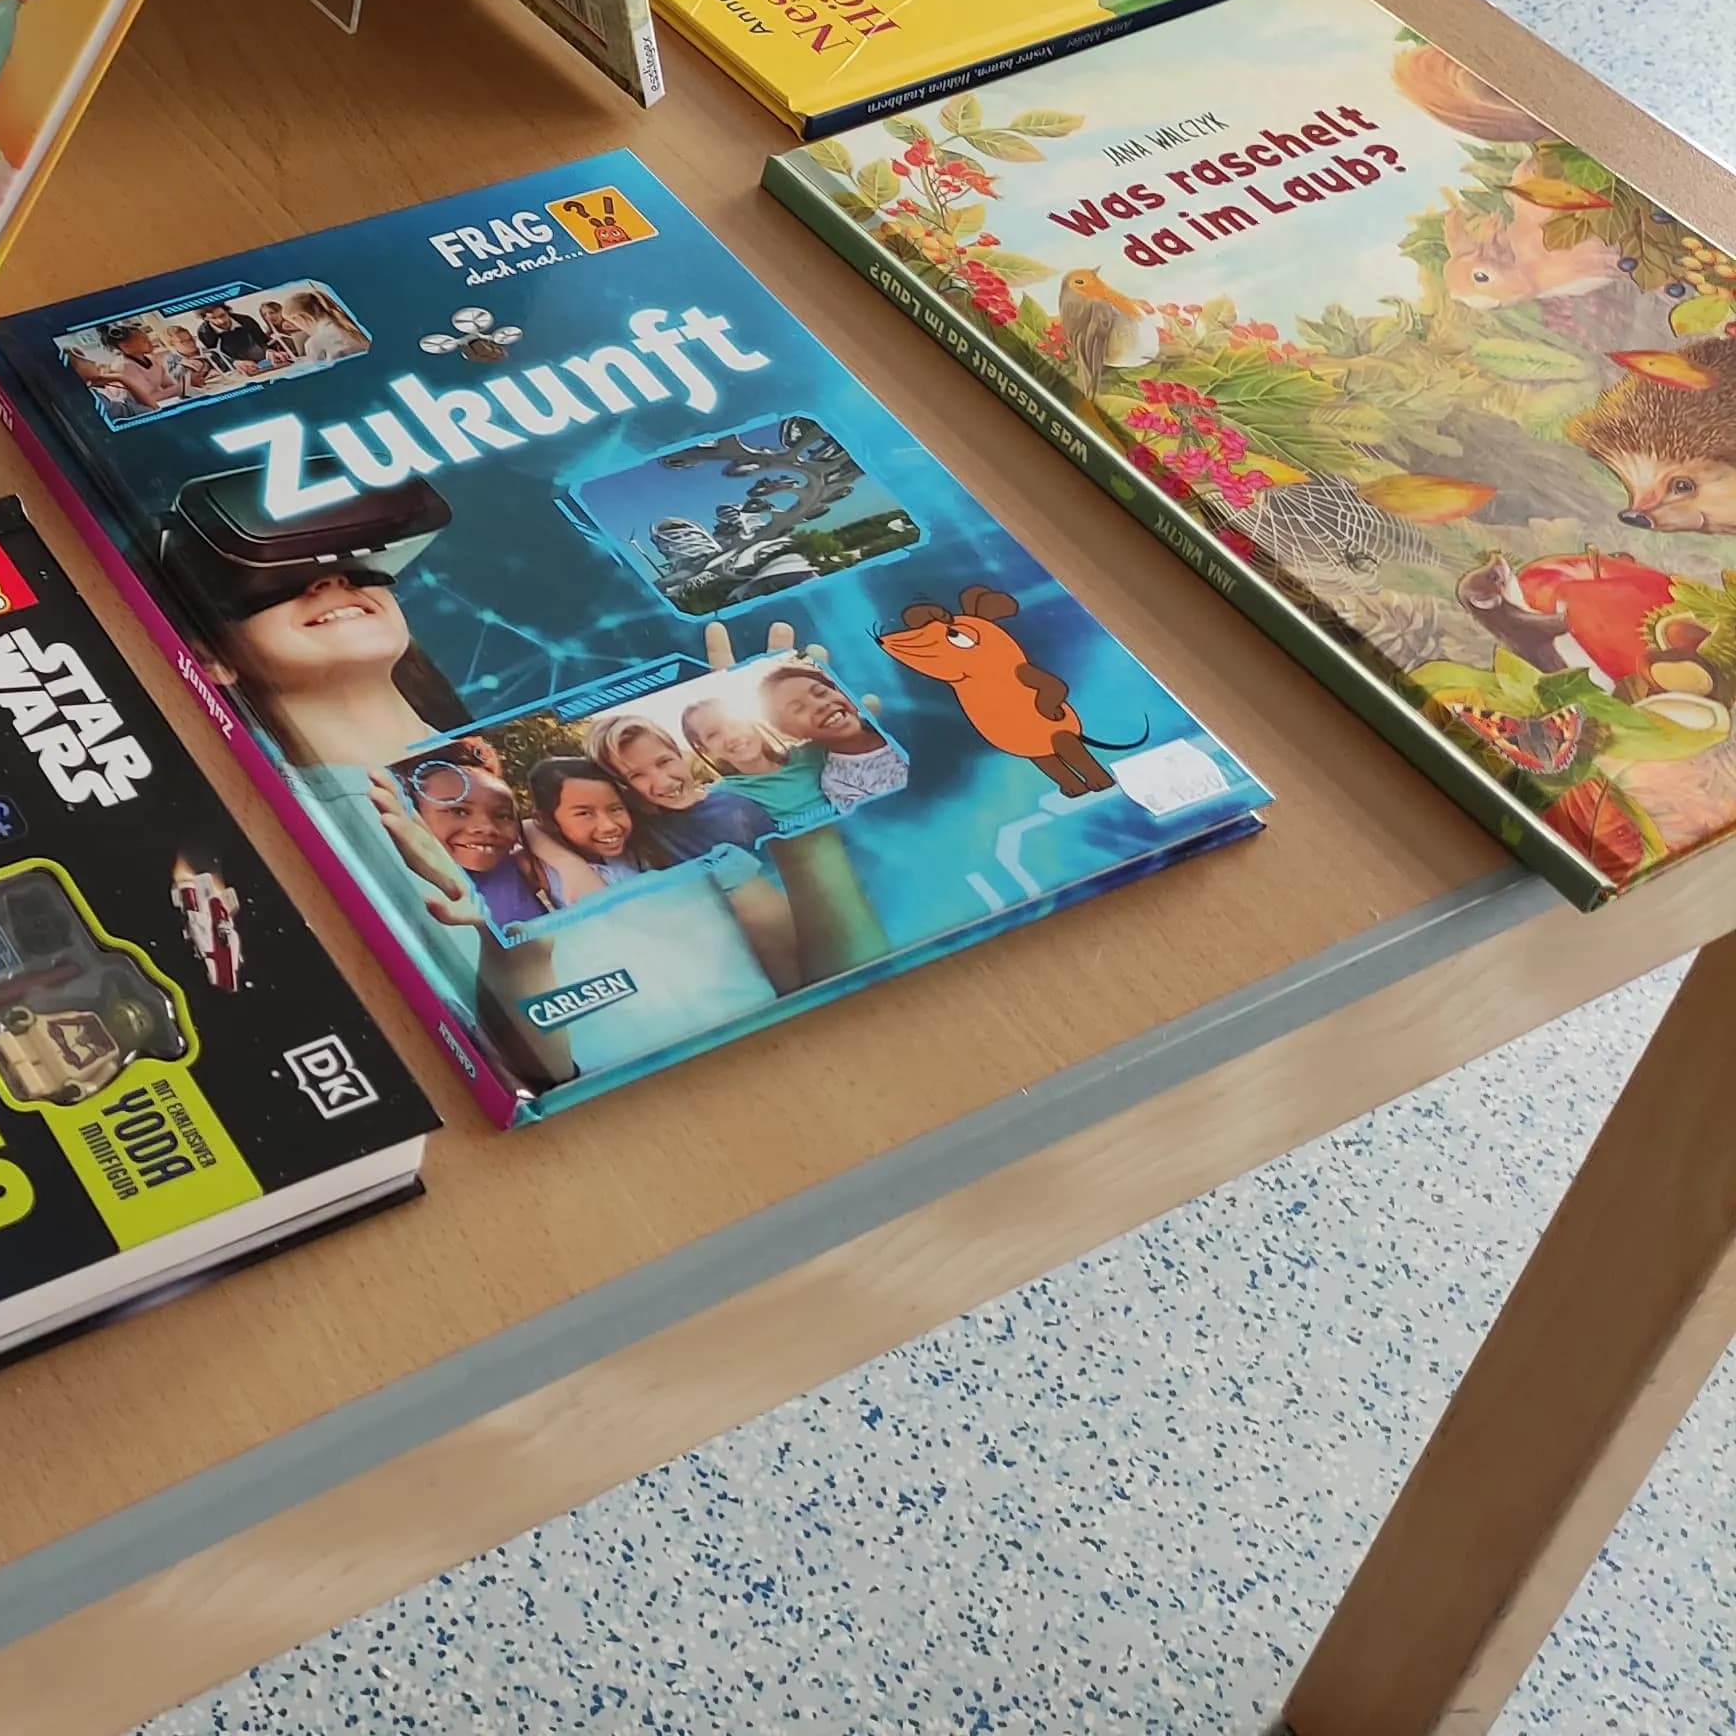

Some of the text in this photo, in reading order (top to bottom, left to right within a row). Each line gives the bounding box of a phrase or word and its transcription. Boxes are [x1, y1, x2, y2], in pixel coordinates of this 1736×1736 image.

[640, 35, 661, 94] esslinger
[1047, 105, 1380, 238] Was raschelt
[1102, 112, 1231, 166] JANA WALCZYK
[429, 211, 554, 269] FRAG
[1123, 144, 1408, 268] da im Laub?
[465, 261, 517, 287] doch
[868, 263, 1089, 463] Was raschelt da im Laub?
[211, 306, 771, 523] Zukunft
[1154, 514, 1238, 593] JANA WALCZYK
[9, 627, 153, 802] STAR
[177, 650, 234, 740] Zukunft
[527, 971, 632, 1027] CARLSEN
[300, 1049, 355, 1104] DK
[78, 1122, 141, 1202] MINIFIGUR
[101, 1087, 197, 1189] YODA
[151, 1080, 217, 1169] MIT EXKLUSIVER
